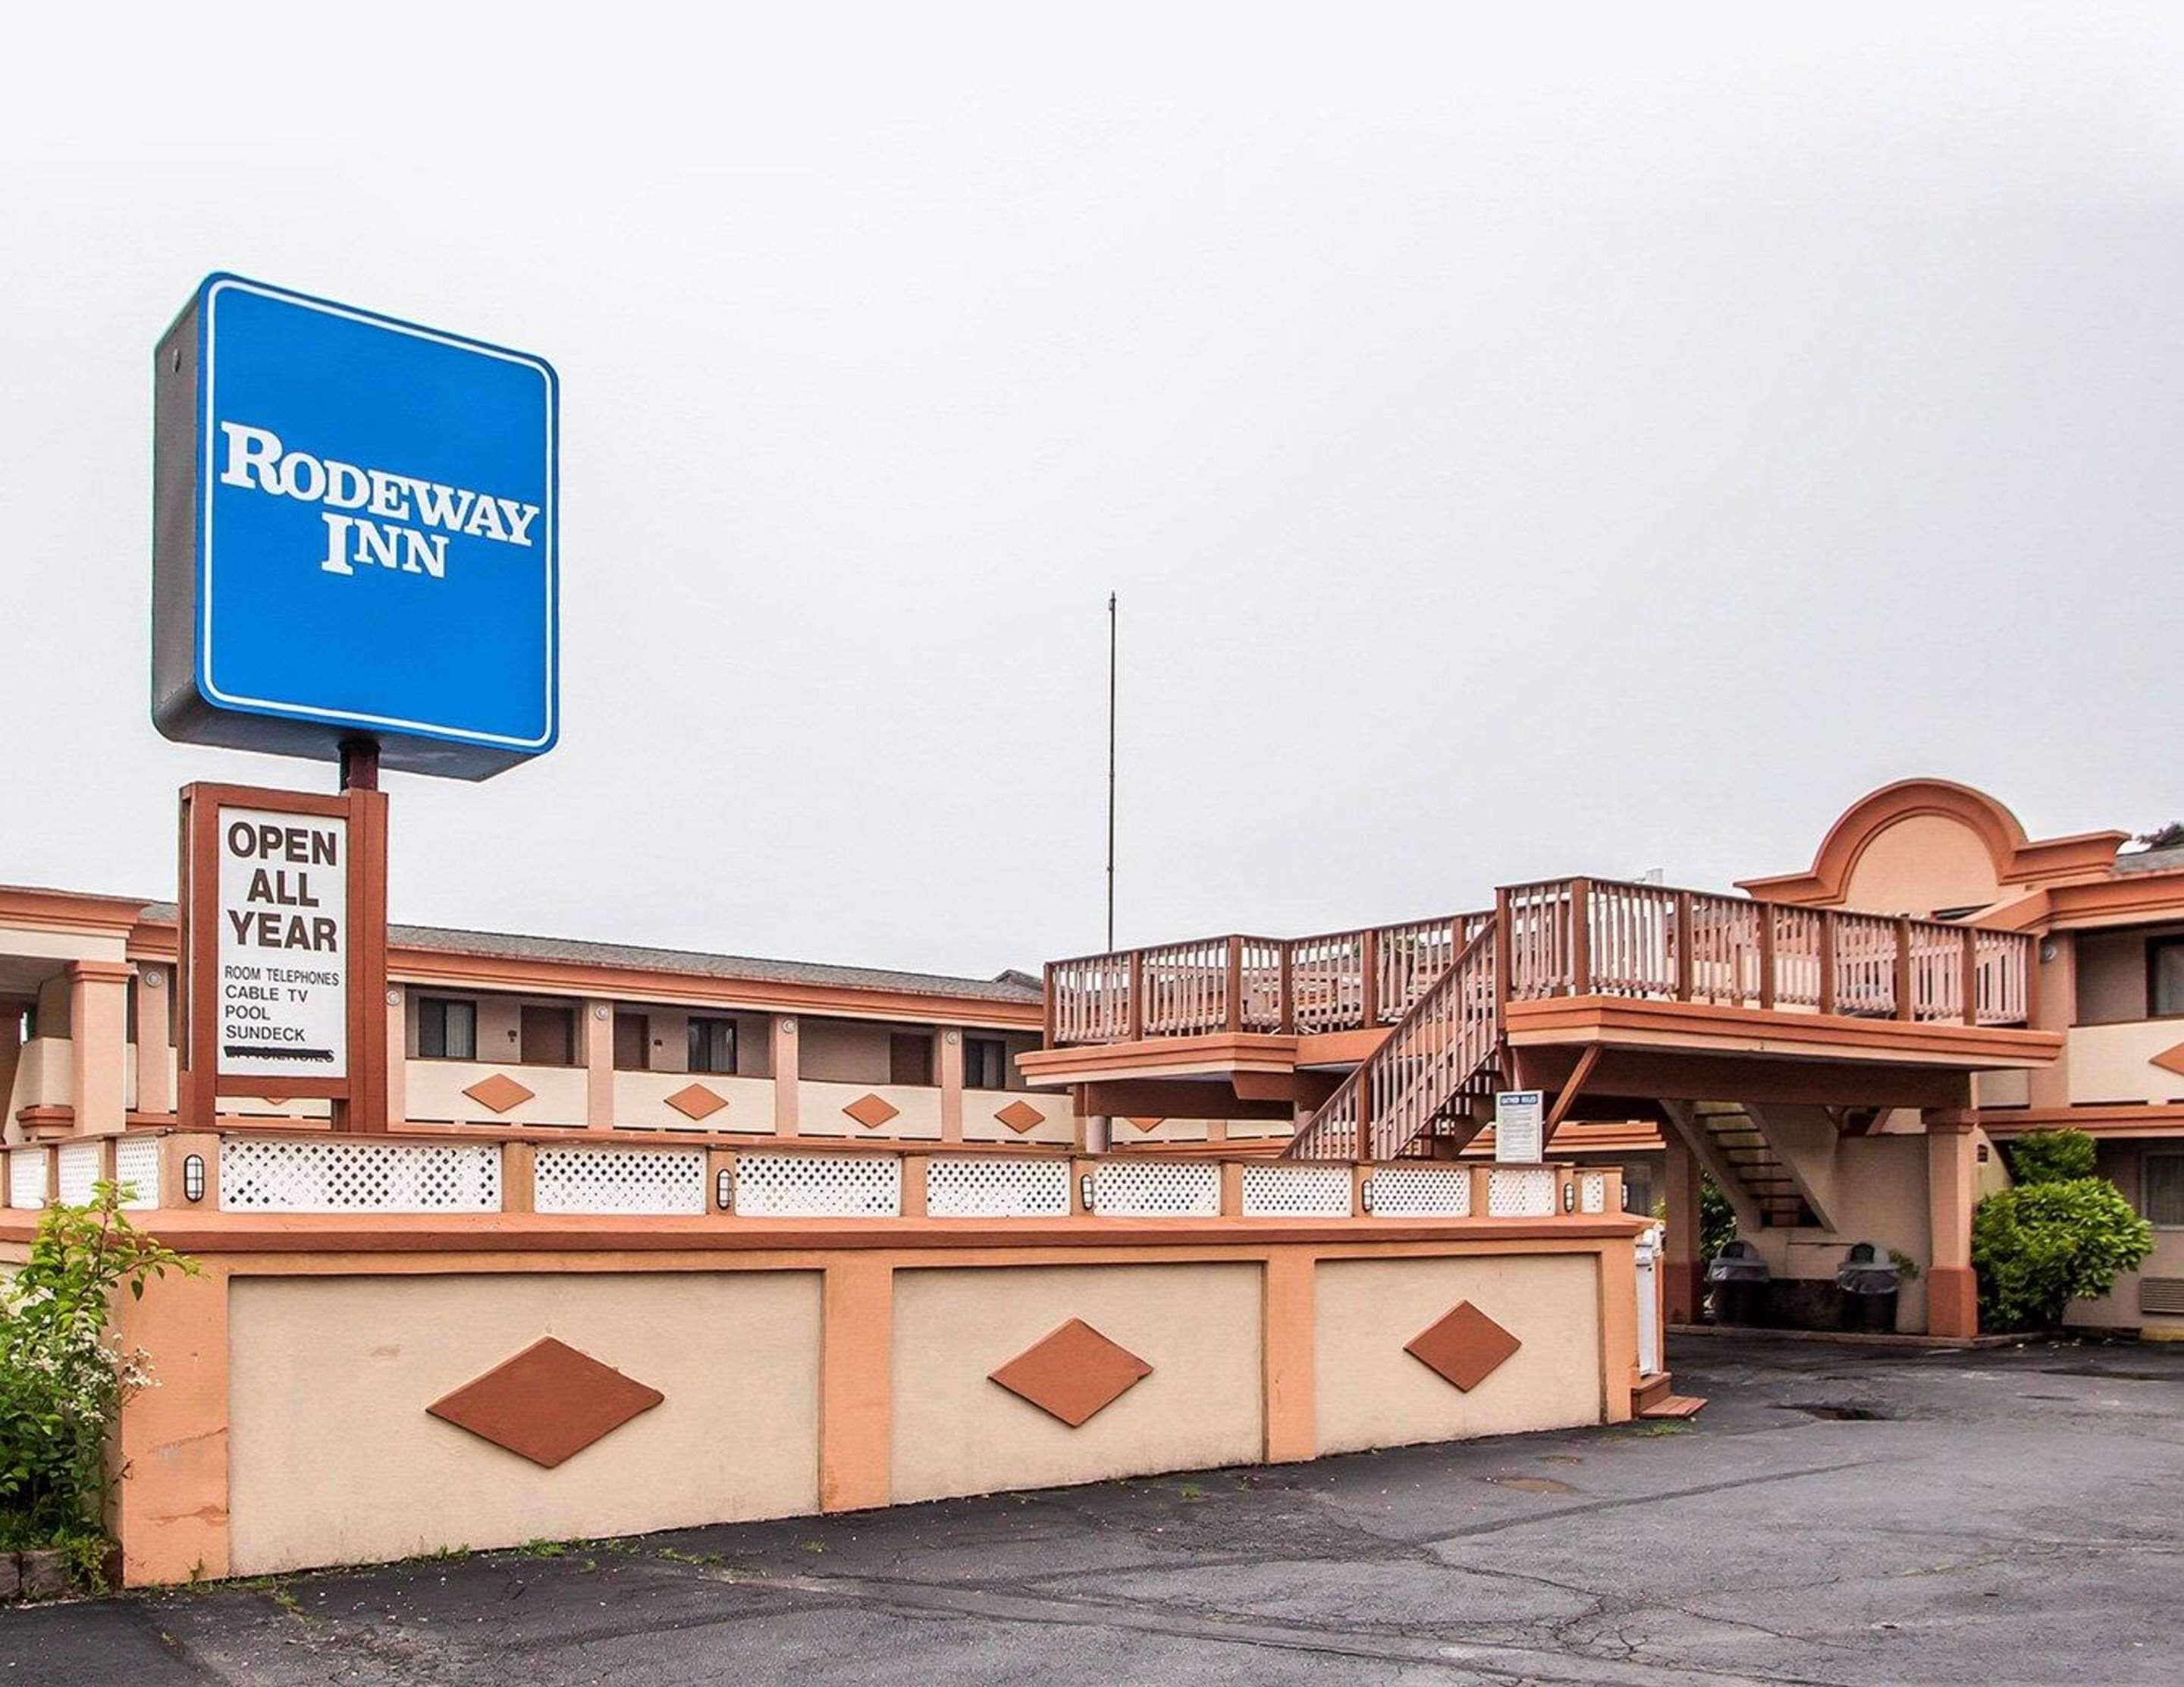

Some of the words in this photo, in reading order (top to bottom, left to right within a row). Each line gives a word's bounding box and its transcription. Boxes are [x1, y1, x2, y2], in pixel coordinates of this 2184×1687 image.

[221, 421, 540, 547] RODEWAY
[322, 512, 450, 578] INN
[228, 822, 336, 866] OPEN
[247, 868, 319, 907] ALL
[228, 909, 337, 952] YEAR
[224, 965, 261, 980] ROOM
[266, 968, 340, 986] TELEPHONES
[225, 985, 280, 1001] CABLE
[287, 989, 309, 1002] TV
[225, 1005, 271, 1020] POOL
[226, 1025, 306, 1041] SUNDECK
